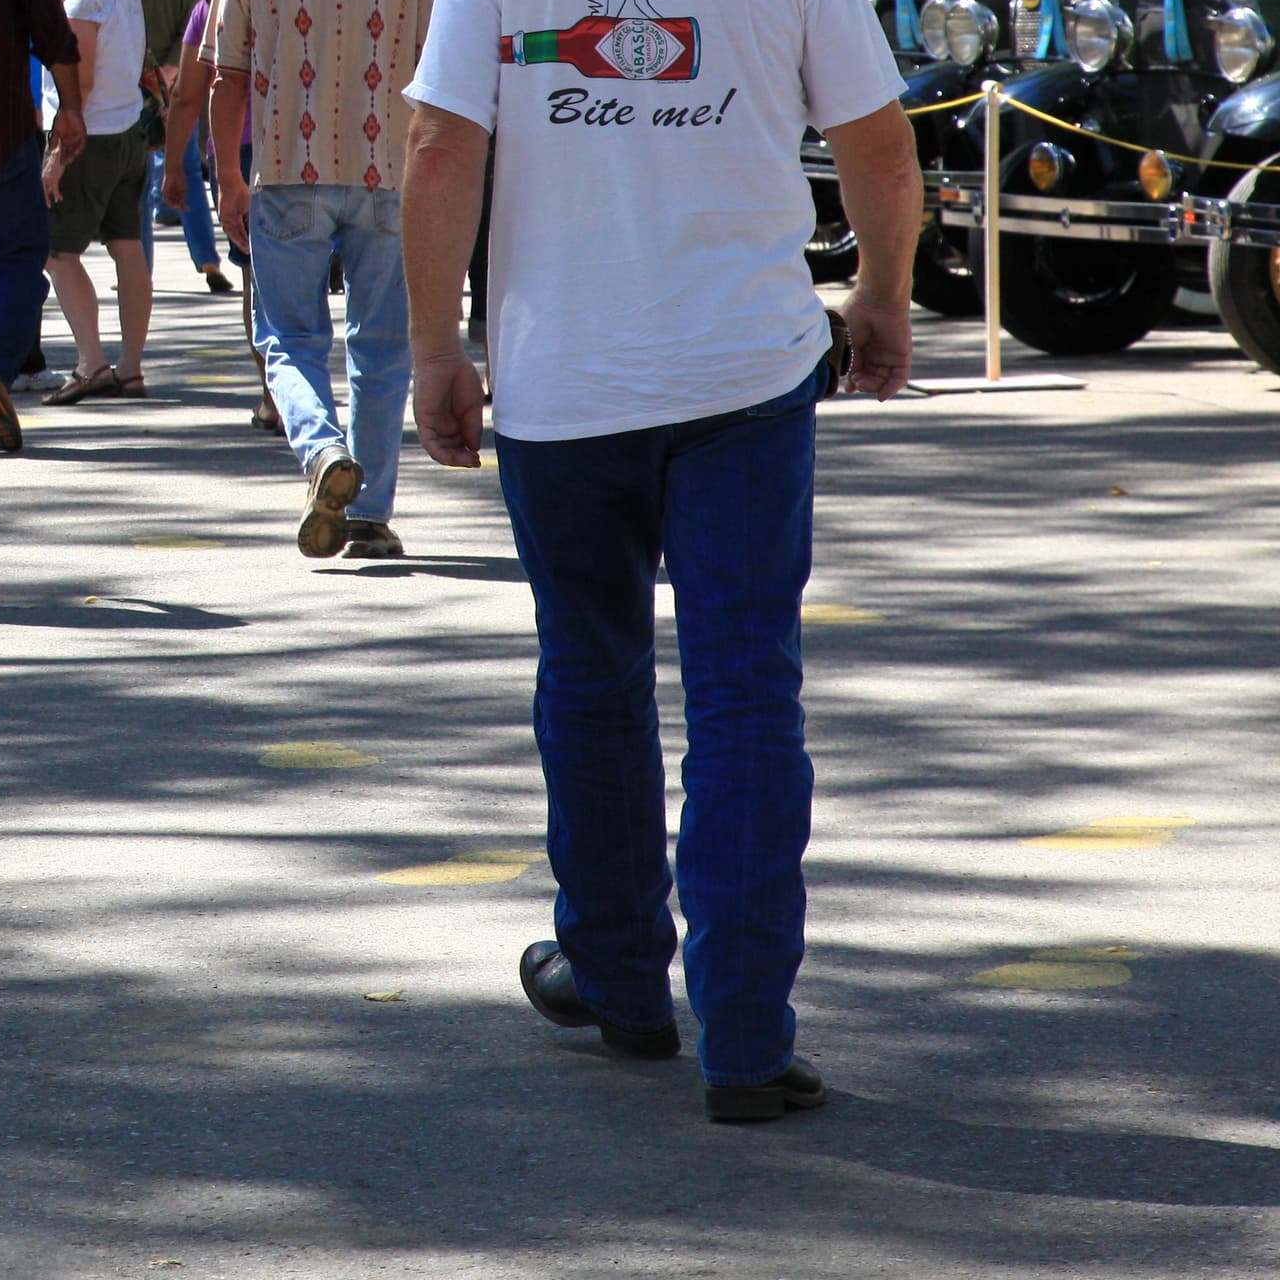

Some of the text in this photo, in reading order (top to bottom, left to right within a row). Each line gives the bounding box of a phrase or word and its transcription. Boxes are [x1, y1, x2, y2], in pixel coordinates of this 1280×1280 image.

[632, 19, 645, 78] TABASCO
[645, 47, 665, 72] PEPPER
[547, 87, 737, 127] Bite me!
